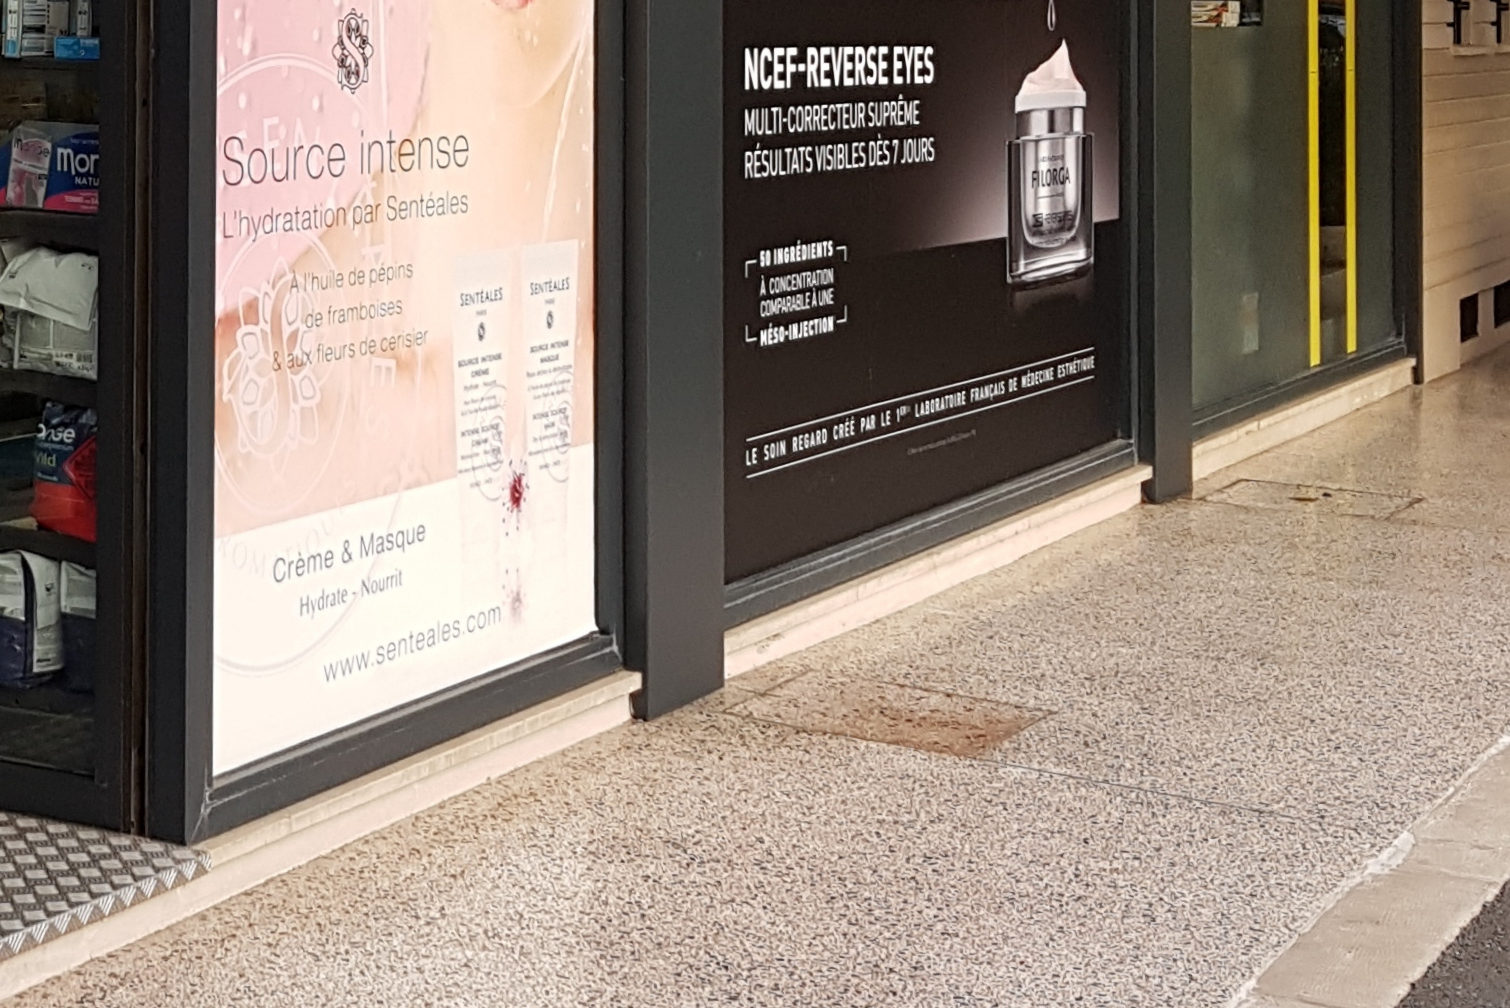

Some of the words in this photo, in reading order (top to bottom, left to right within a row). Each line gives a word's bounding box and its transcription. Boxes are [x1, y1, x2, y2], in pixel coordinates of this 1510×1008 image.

[744, 46, 888, 90] NCEF-REVERSE
[892, 46, 934, 85] EYES
[744, 102, 865, 136] MULTI-CORRECTEUR
[868, 94, 920, 127] SUPRÊME
[222, 136, 346, 186] Source
[360, 129, 470, 175] intense
[744, 143, 812, 179] RÉSULTATS
[815, 142, 866, 171] VISIBLES
[869, 134, 890, 167] DÈS
[892, 140, 898, 164] 7
[900, 137, 935, 164] JOURS
[1032, 166, 1070, 189] FILORGA
[222, 204, 346, 242] L'hydratation
[352, 202, 381, 231] par
[386, 191, 468, 222] Sentéales
[760, 249, 771, 267] 50
[774, 239, 833, 265] INGRÉDIENTS
[304, 270, 343, 292] l'huile
[348, 268, 365, 287] de
[368, 262, 414, 288] pépins
[460, 287, 503, 307] SENTÉALES
[530, 277, 570, 296] SENTÉALES
[769, 268, 833, 294] CONCENTRATION
[305, 308, 323, 329] de
[327, 299, 402, 325] framboises
[760, 292, 810, 317] COMPARABLE
[818, 288, 834, 306] UNE
[272, 351, 282, 372] &
[286, 351, 313, 369] aux
[316, 342, 356, 363] fleurs
[359, 338, 377, 357] de
[381, 330, 428, 352] cerisier
[746, 448, 757, 466] LE
[764, 440, 786, 461] SOIN
[792, 428, 827, 452] REGARD
[833, 416, 855, 440] CRÉÉ
[861, 415, 875, 433] PAR
[881, 410, 890, 427] LE
[915, 391, 966, 418] LABORATOIRE
[970, 381, 1005, 404] FRANÇAIS
[1009, 377, 1017, 392] DE
[1021, 367, 1054, 388] MÉDECINE
[1058, 356, 1095, 378] ESTHÉTIQUE
[273, 550, 334, 583] Crème
[342, 540, 353, 564] &
[359, 524, 426, 558] Masque
[299, 585, 348, 619] Hydrate
[361, 569, 403, 597] Nourrit
[324, 606, 501, 682] www.senteales.com
